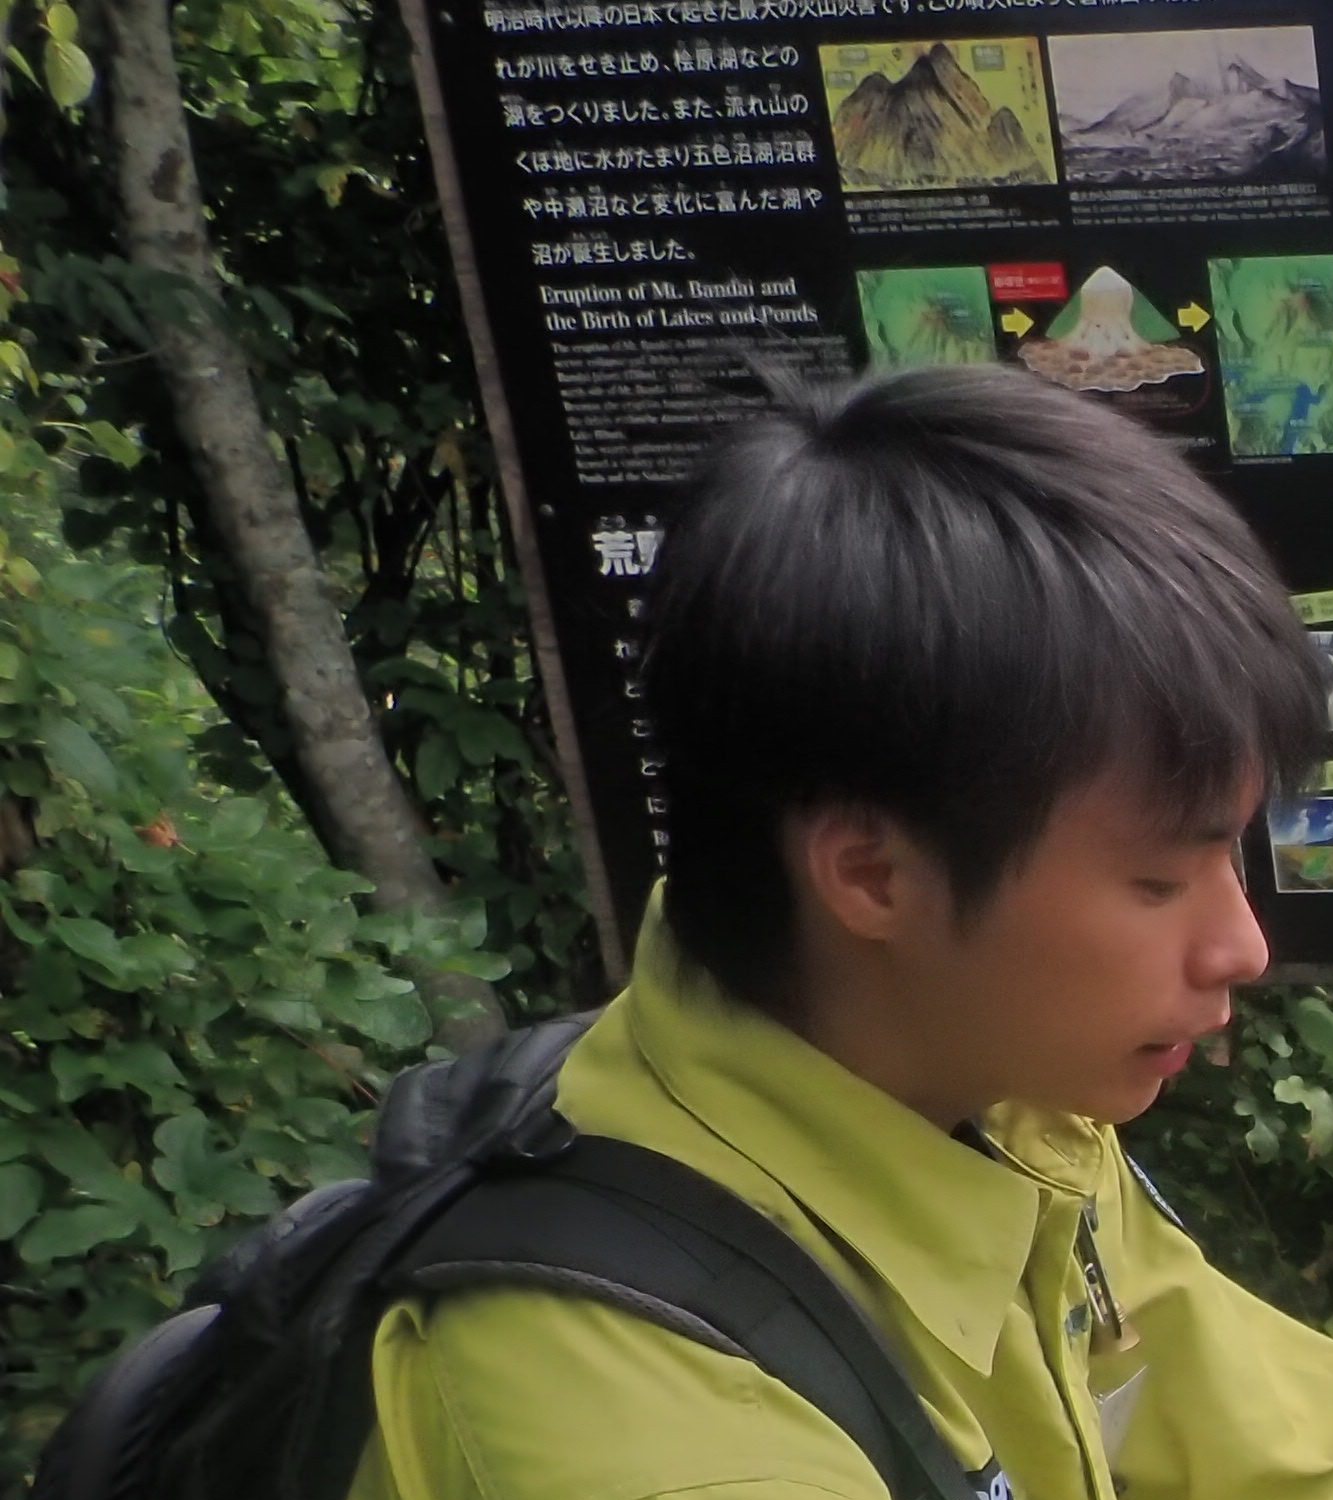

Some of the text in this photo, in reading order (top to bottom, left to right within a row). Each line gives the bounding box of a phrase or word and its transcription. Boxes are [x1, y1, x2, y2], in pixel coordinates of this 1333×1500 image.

[532, 240, 696, 267] 沼が誕生しました。
[540, 277, 797, 308] Eruption of Mt. Bandai and
[546, 303, 818, 331] the Birth of Lakes and Ponds
